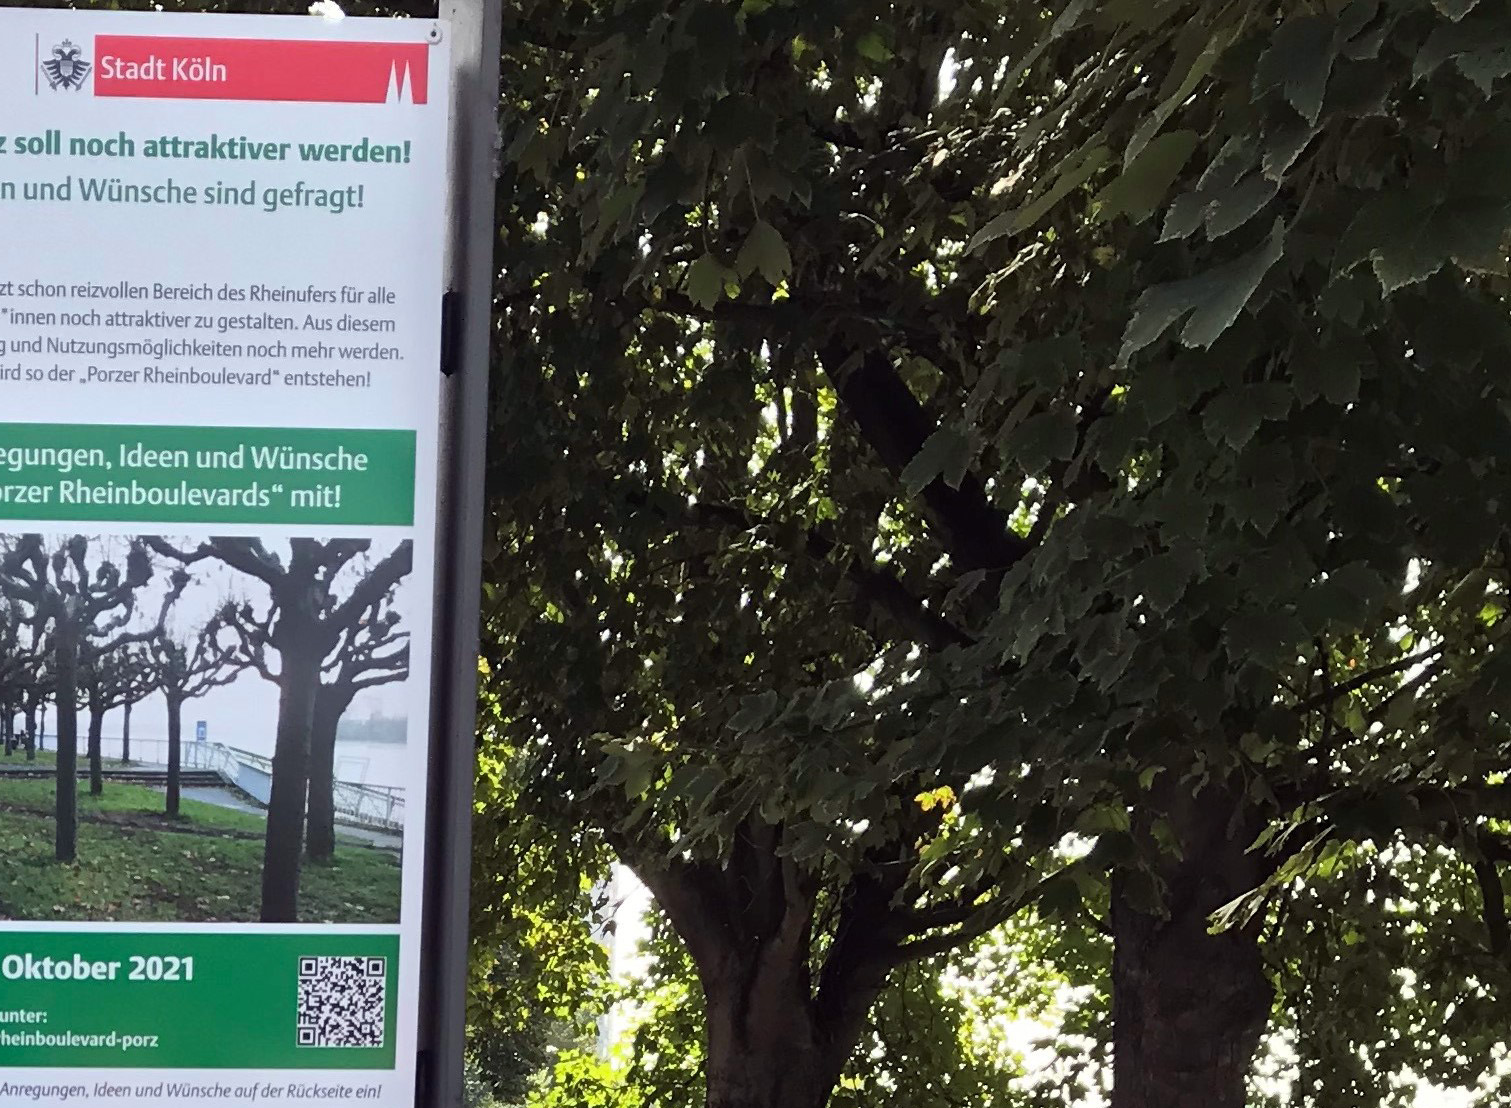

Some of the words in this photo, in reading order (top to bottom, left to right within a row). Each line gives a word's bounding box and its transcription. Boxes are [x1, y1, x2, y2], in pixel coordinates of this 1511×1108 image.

[100, 54, 167, 80] Stadt
[172, 56, 227, 82] Köln
[13, 129, 61, 156] soll
[69, 130, 135, 158] noch
[142, 133, 292, 162] attraktiver
[298, 137, 411, 165] werden!
[23, 175, 72, 202] und
[78, 177, 198, 205] Wünsche
[203, 180, 256, 207] sind
[262, 181, 364, 214] gefragt!
[17, 278, 67, 298] schon
[70, 280, 149, 300] reizvollen
[153, 282, 213, 301] Bereich
[217, 282, 246, 302] des
[249, 283, 337, 304] Rheinufers
[340, 285, 365, 304] für
[367, 286, 396, 305] alle
[60, 308, 101, 327] noch
[104, 309, 192, 328] attraktiver
[194, 315, 215, 330] zu
[217, 312, 299, 334] gestalten.
[302, 313, 333, 332] Aus
[336, 312, 396, 333] diesem
[10, 335, 43, 353] und
[46, 336, 243, 361] Nutzungsmöglichkeiten
[246, 339, 287, 358] noch
[291, 341, 336, 360] mehr
[337, 341, 404, 361] werden.
[25, 368, 44, 381] so
[47, 363, 76, 382] der
[283, 368, 371, 388] entstehen!
[119, 441, 189, 469] Ideen
[196, 443, 244, 469] und
[250, 445, 369, 472] Wünsche
[290, 484, 341, 509] mit!
[1, 952, 122, 981] Oktober
[128, 955, 194, 982] 2021
[93, 1081, 132, 1097] Ideen
[134, 1082, 164, 1098] und
[166, 1082, 232, 1099] Wünsche
[234, 1082, 260, 1102] auf
[260, 1082, 285, 1098] der
[286, 1082, 354, 1099] Rückseite
[355, 1084, 383, 1099] ein!
